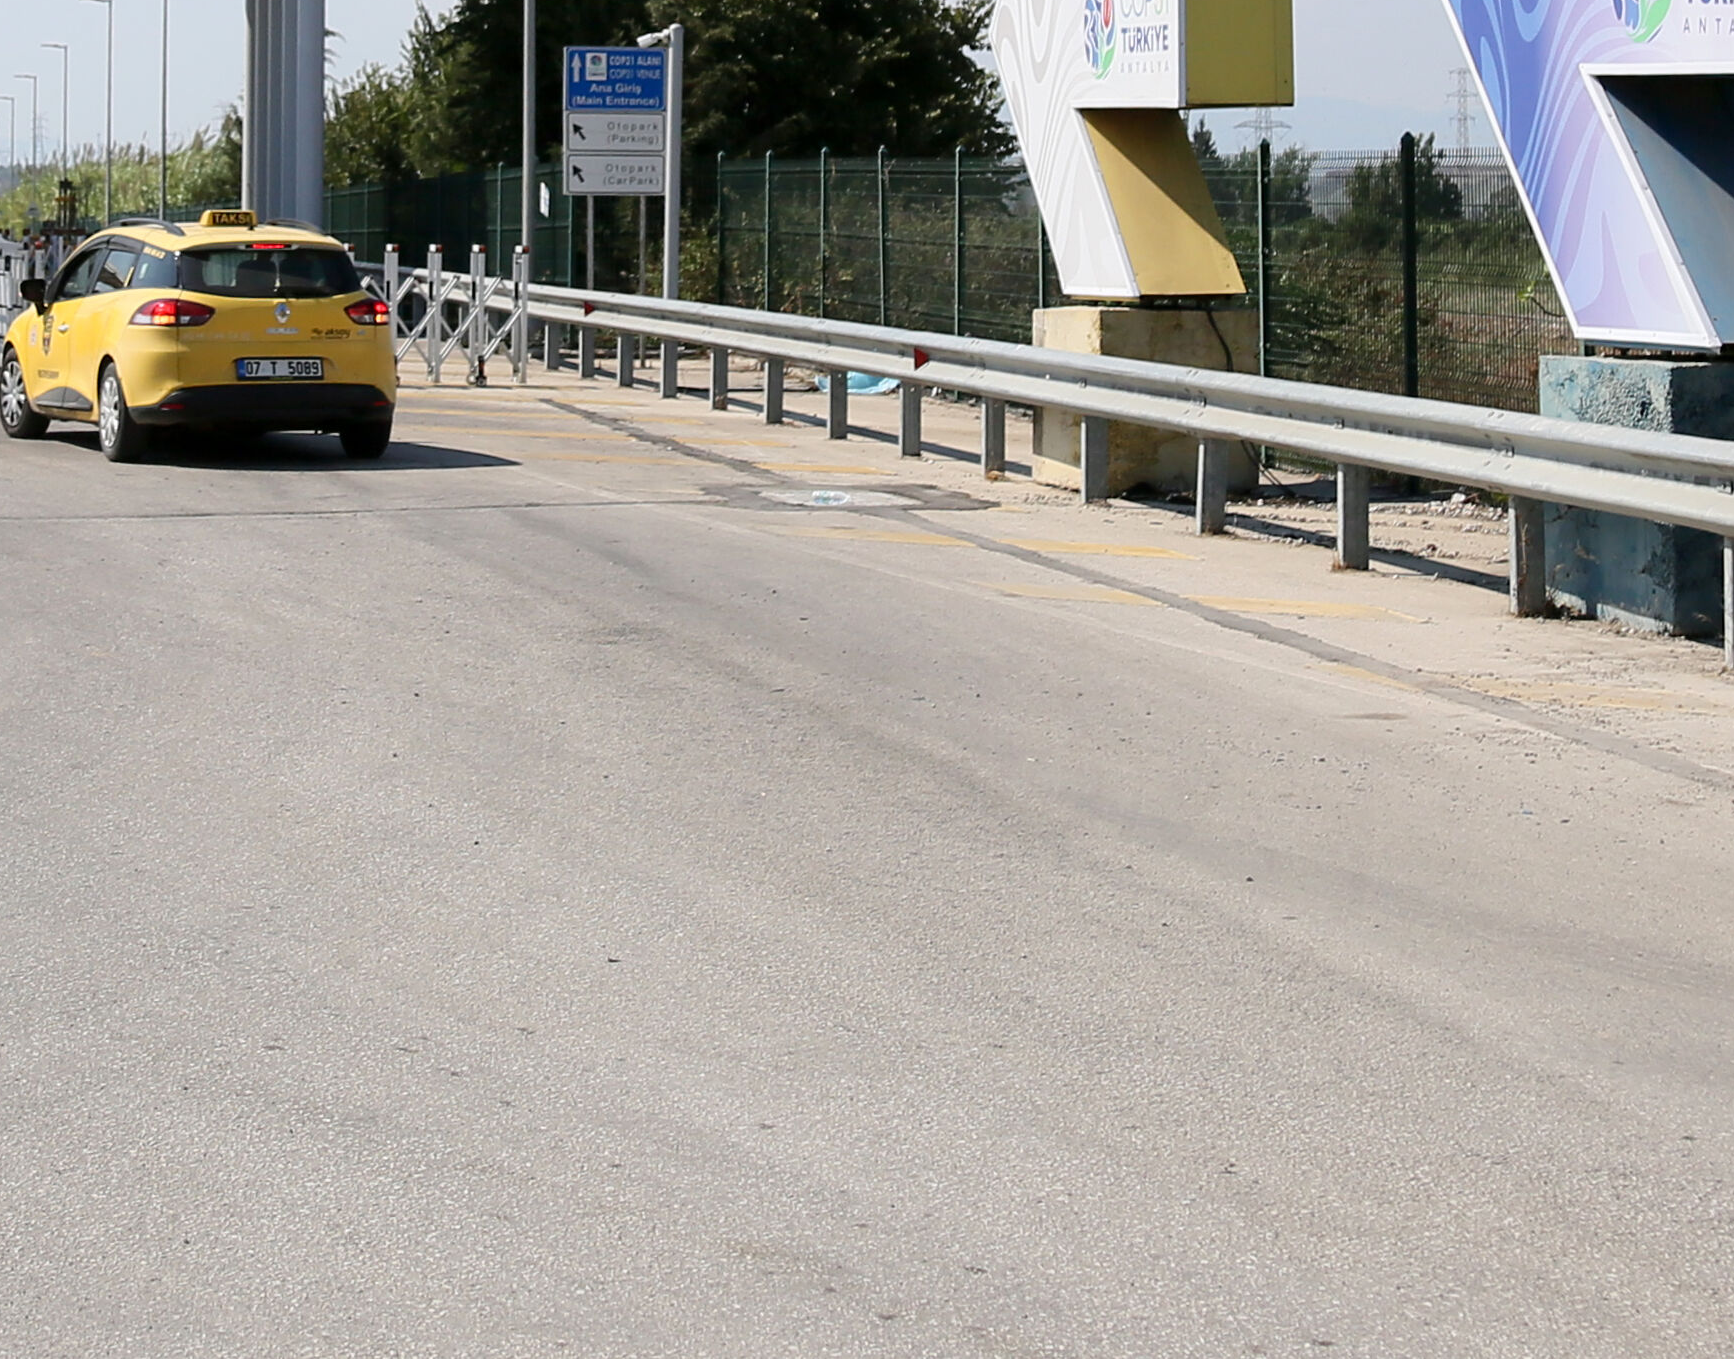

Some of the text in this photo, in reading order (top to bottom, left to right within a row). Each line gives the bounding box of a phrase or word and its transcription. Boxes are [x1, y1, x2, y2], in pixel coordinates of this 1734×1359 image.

[1120, 60, 1170, 74] ANTALYA
[590, 83, 612, 93] Ana
[572, 96, 660, 107] (Main Entrance)
[607, 121, 658, 132] Otopark
[605, 163, 656, 174] Otopark
[245, 362, 319, 375] 07 T 5089
